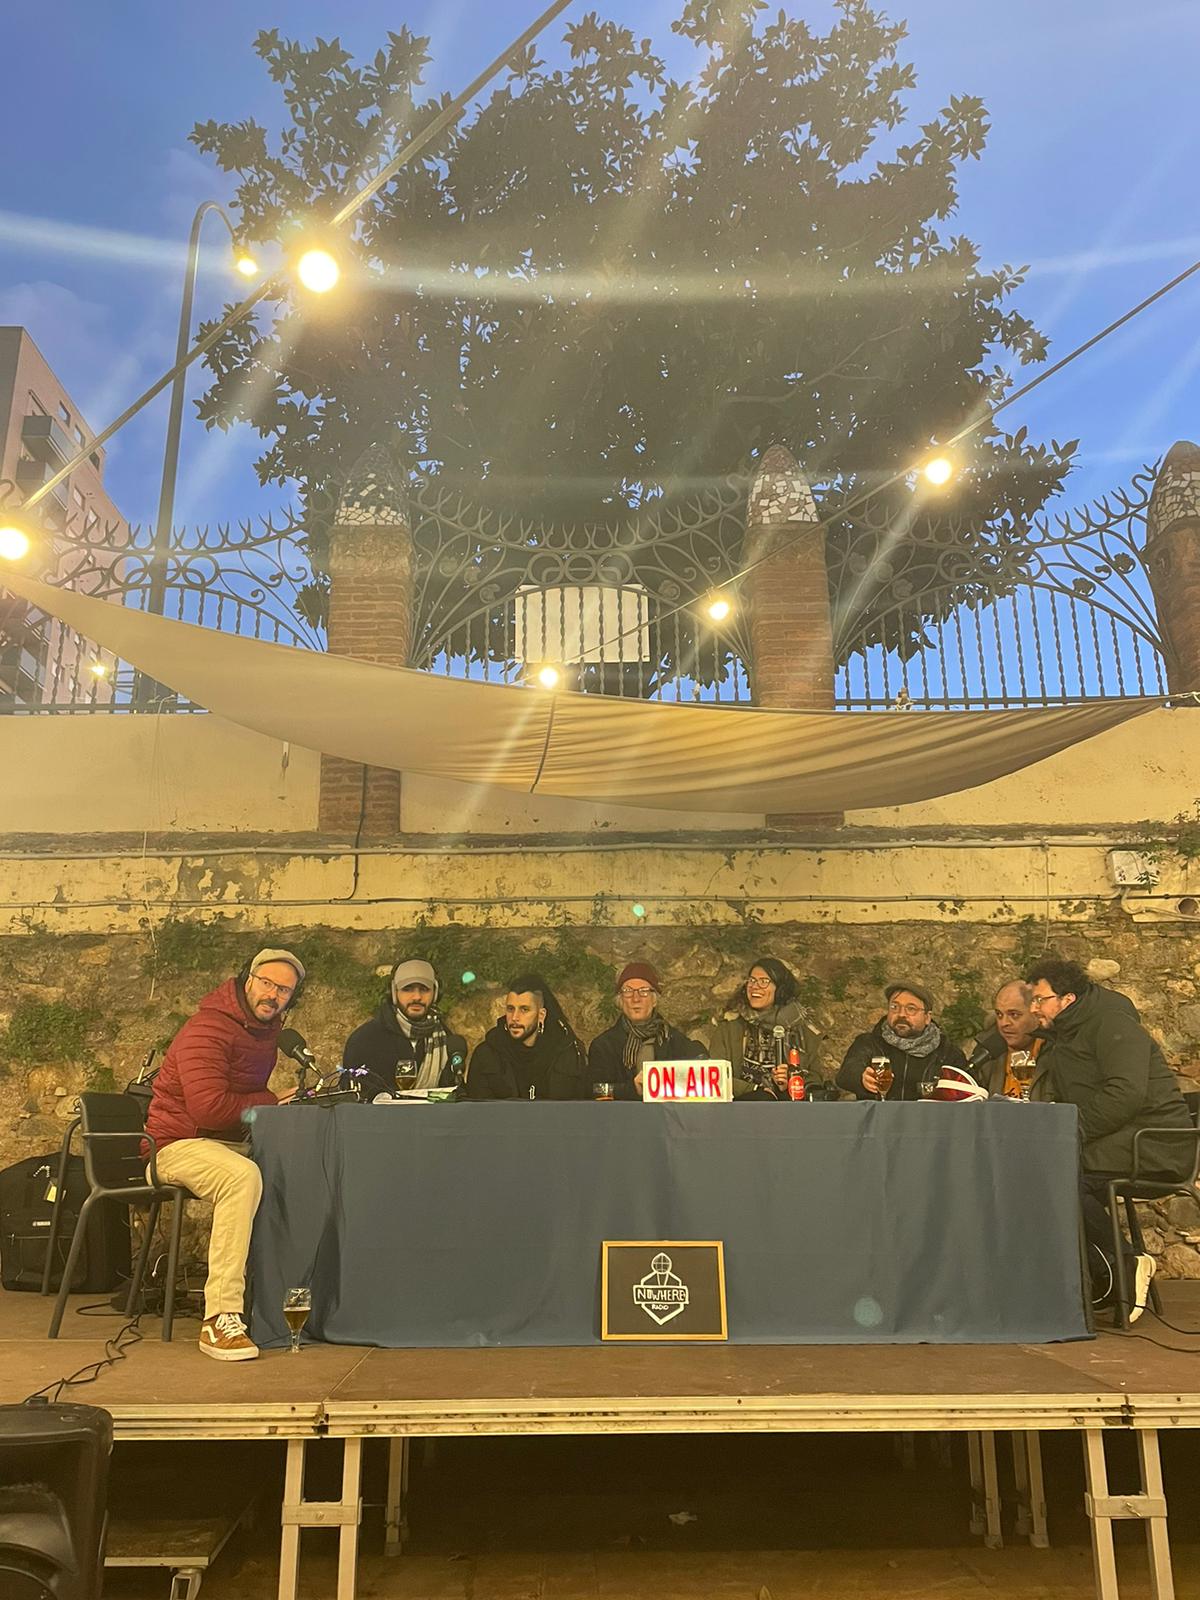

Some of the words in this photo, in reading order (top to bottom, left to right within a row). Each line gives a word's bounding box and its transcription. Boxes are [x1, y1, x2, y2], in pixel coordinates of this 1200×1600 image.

[647, 1066, 676, 1098] ON
[686, 1066, 721, 1098] AIR
[637, 1288, 686, 1301] NOWHERE
